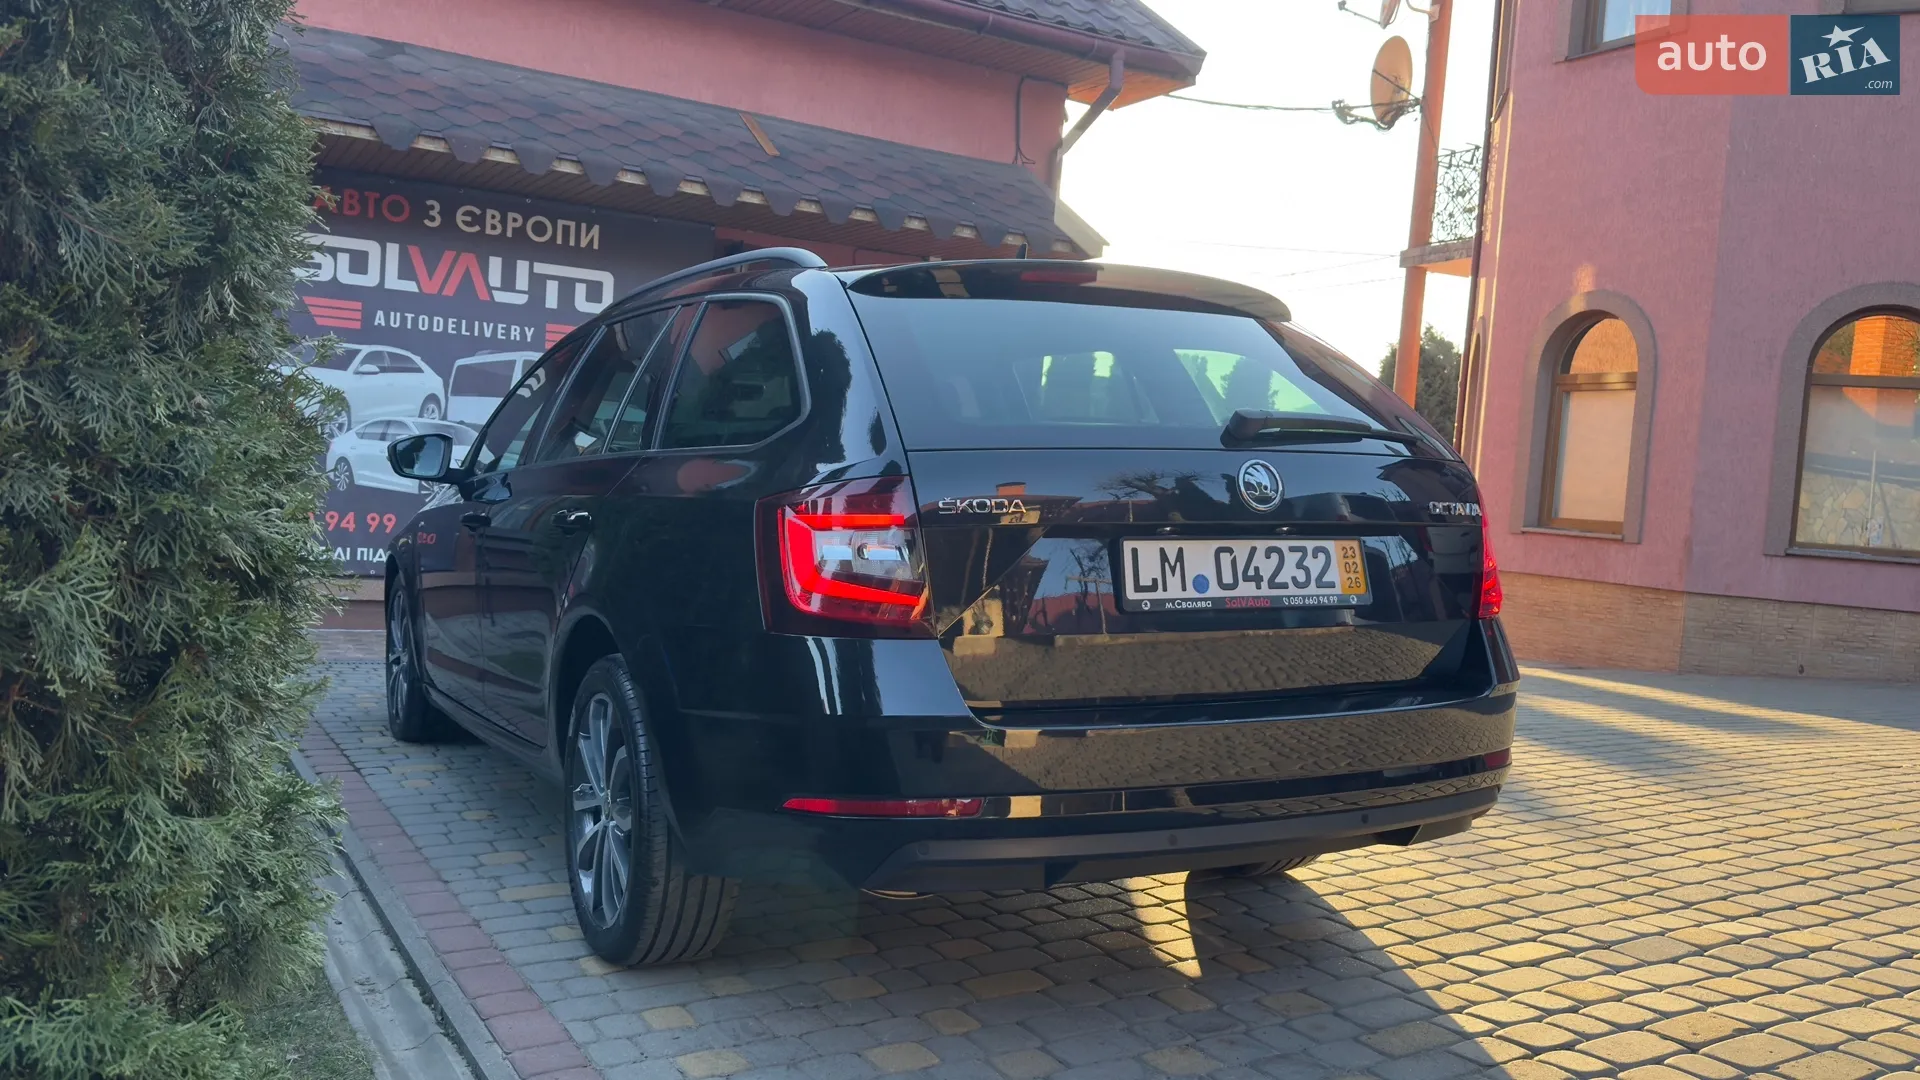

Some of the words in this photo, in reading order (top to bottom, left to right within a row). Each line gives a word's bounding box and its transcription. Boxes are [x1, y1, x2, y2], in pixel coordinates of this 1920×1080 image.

[312, 185, 411, 222] АВТО
[455, 204, 600, 250] ЄВРОПИ
[374, 309, 535, 343] AUTODELIVERY
[938, 497, 1027, 514] ŠKODA
[325, 511, 356, 533] 94
[366, 513, 397, 534] 99
[1341, 547, 1357, 559] 23
[1131, 546, 1188, 593] LM
[1214, 546, 1336, 591] 04232
[1344, 562, 1360, 574] 02
[1347, 577, 1362, 589] 26
[1289, 596, 1304, 605] 050
[1305, 596, 1318, 605] 660
[1319, 596, 1329, 605] 94
[1329, 595, 1338, 604] 99
